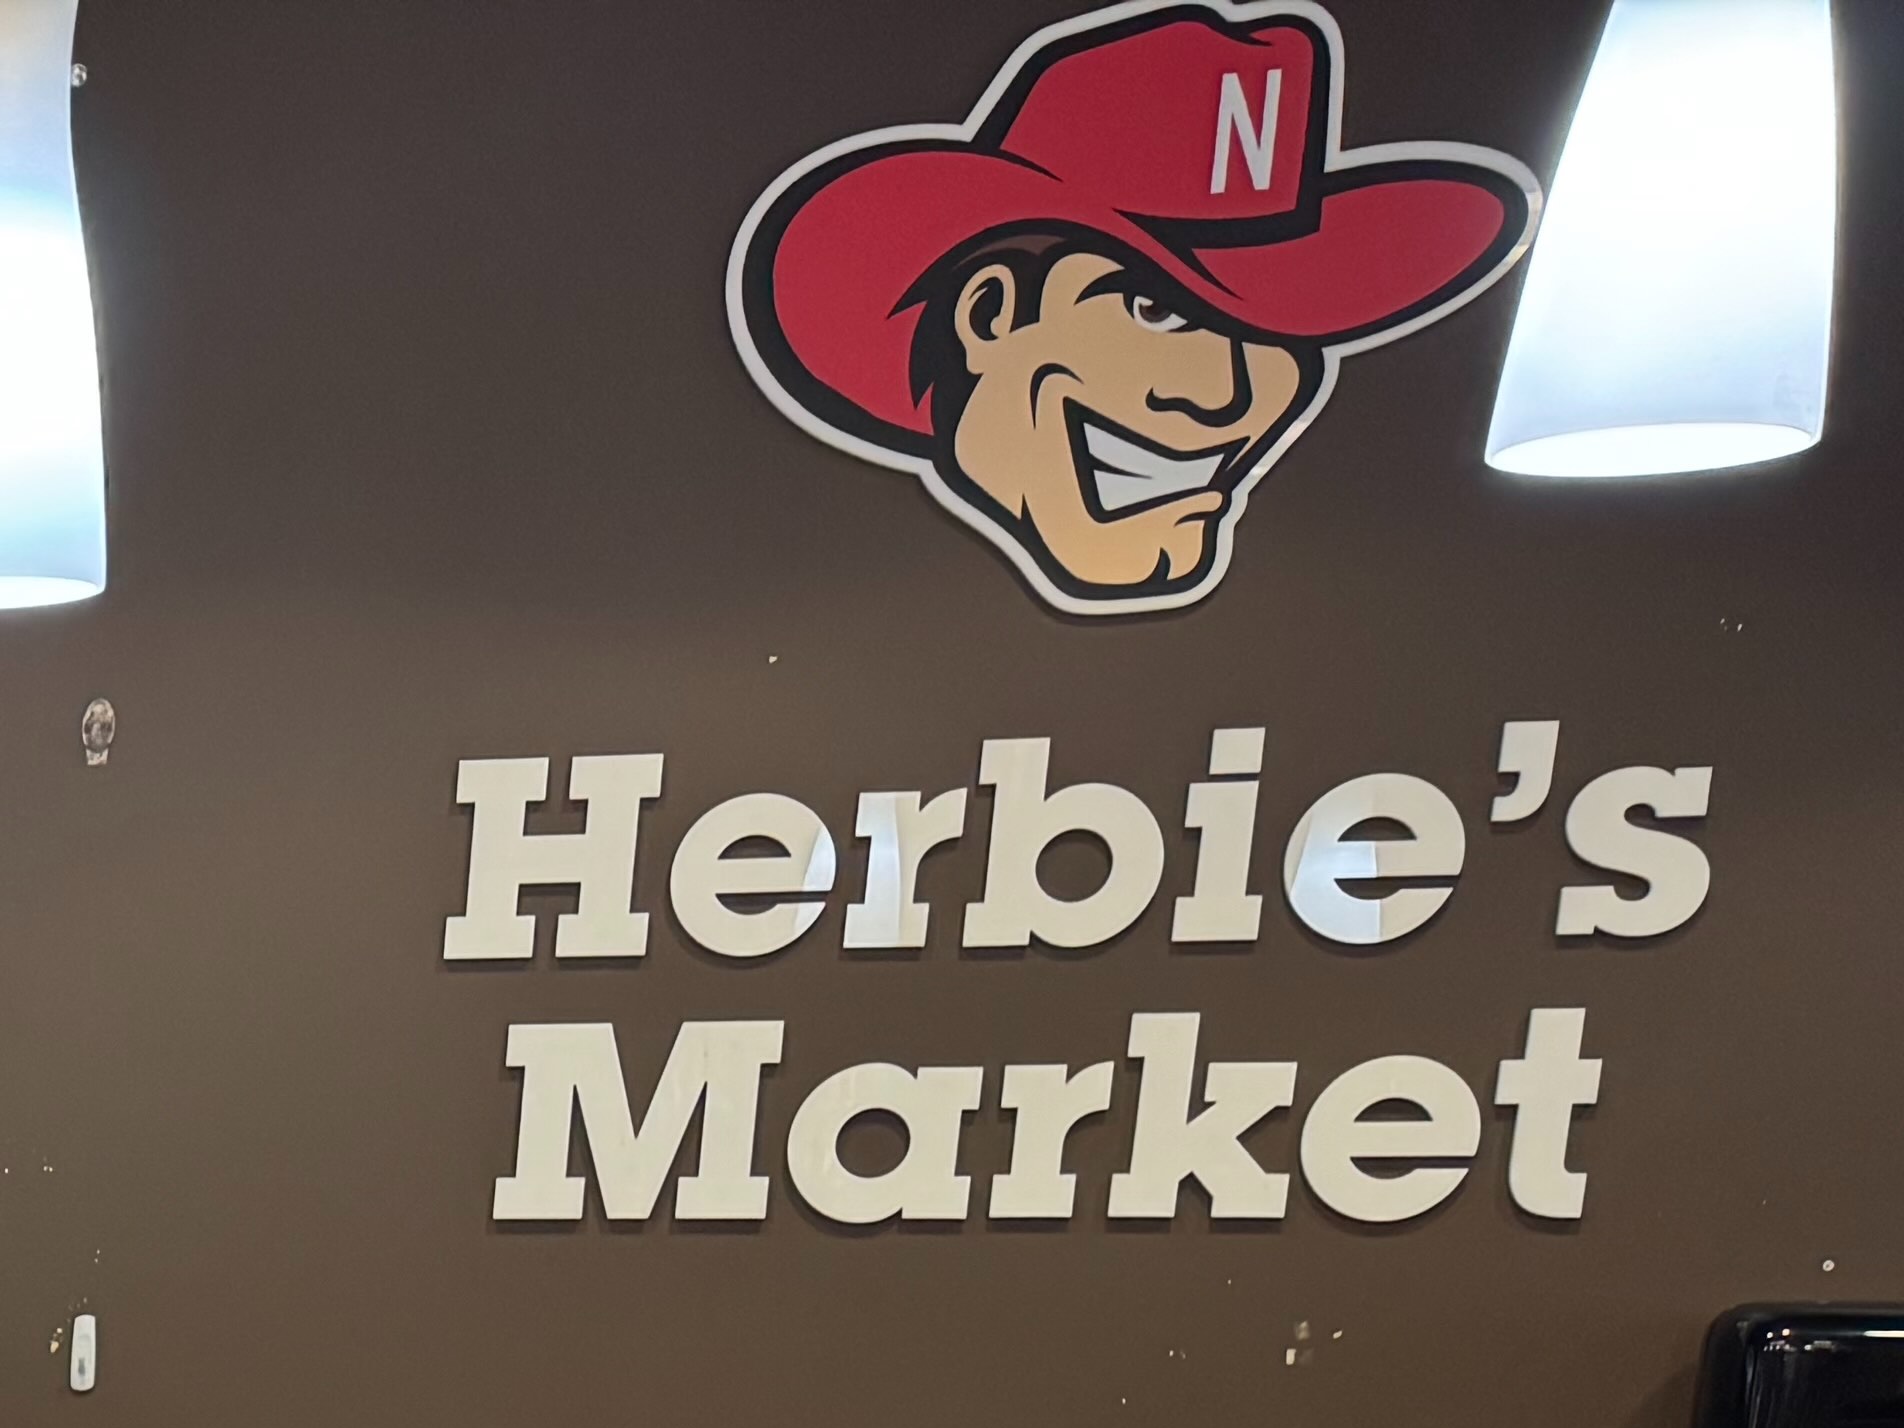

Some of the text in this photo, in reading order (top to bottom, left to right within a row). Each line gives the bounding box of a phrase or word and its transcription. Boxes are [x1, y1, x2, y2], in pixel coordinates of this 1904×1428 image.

[1209, 68, 1282, 194] N
[441, 720, 1713, 960] Herbie's
[492, 1007, 1603, 1224] Market
